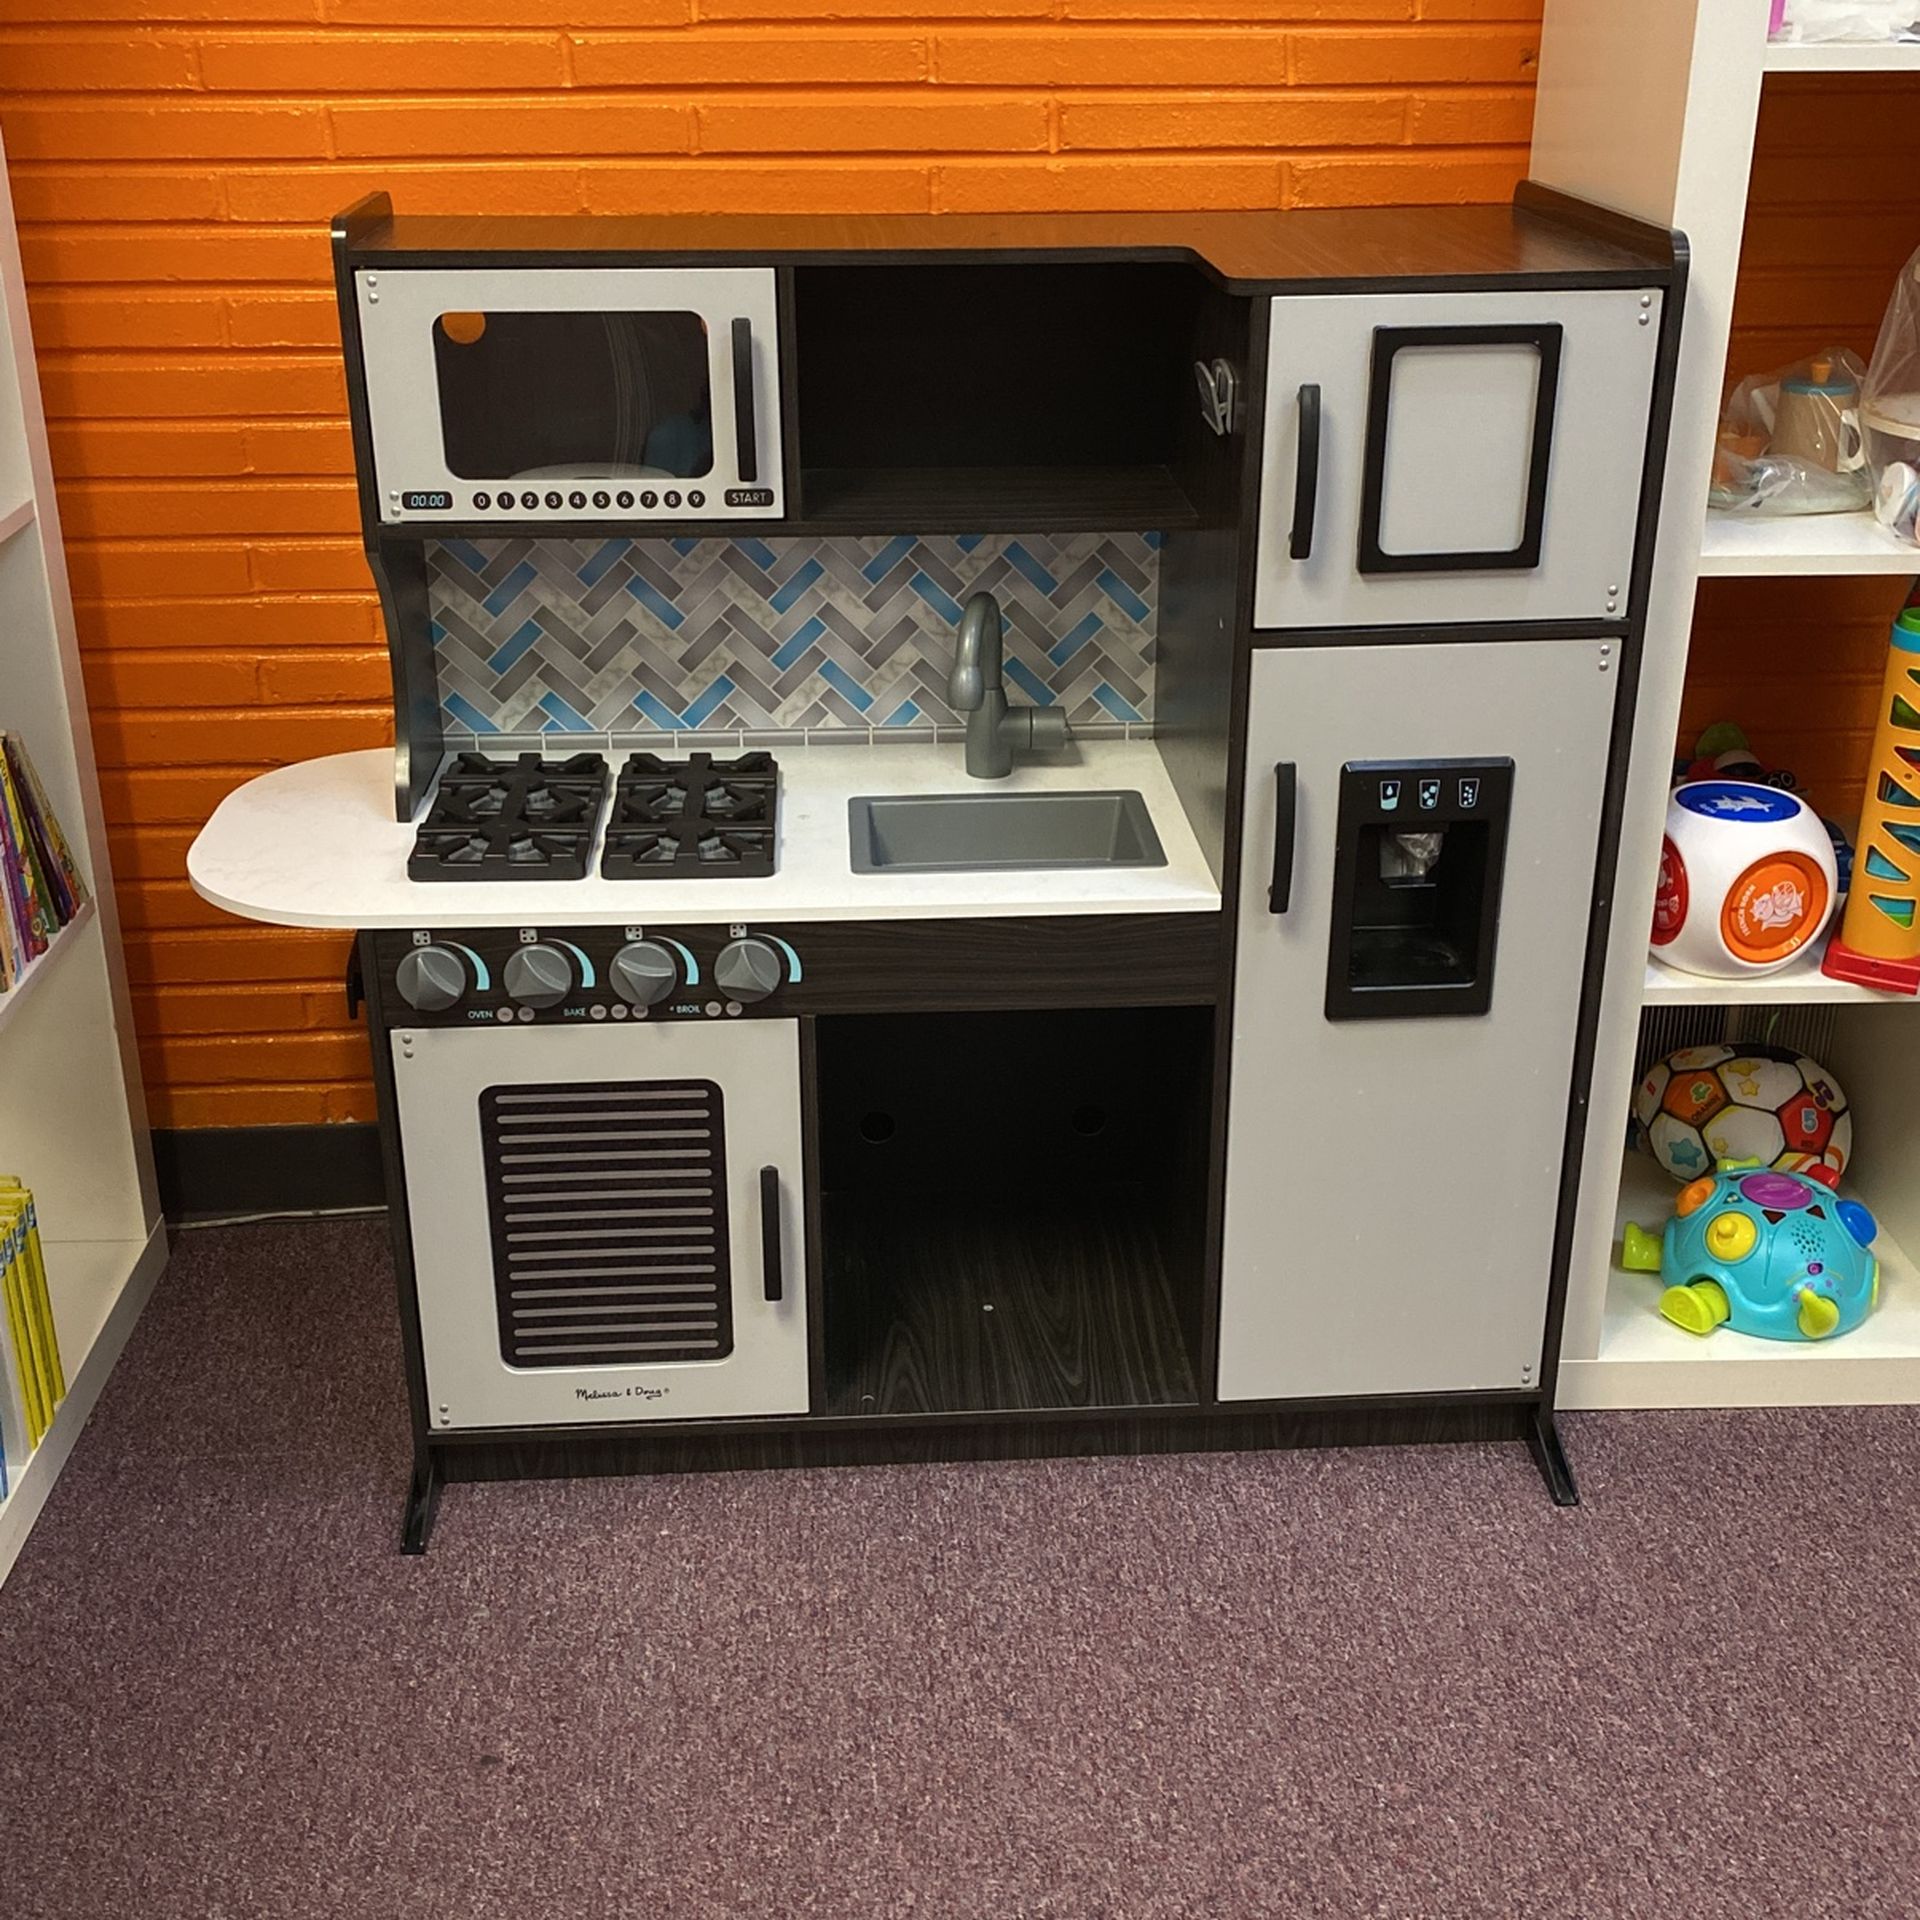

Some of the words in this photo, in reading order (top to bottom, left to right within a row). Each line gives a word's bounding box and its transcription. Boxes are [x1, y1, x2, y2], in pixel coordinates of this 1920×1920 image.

[731, 493, 766, 504] START
[467, 1010, 493, 1019] OVEN
[563, 1008, 586, 1017] BAKE
[1802, 1107, 1818, 1134] 5
